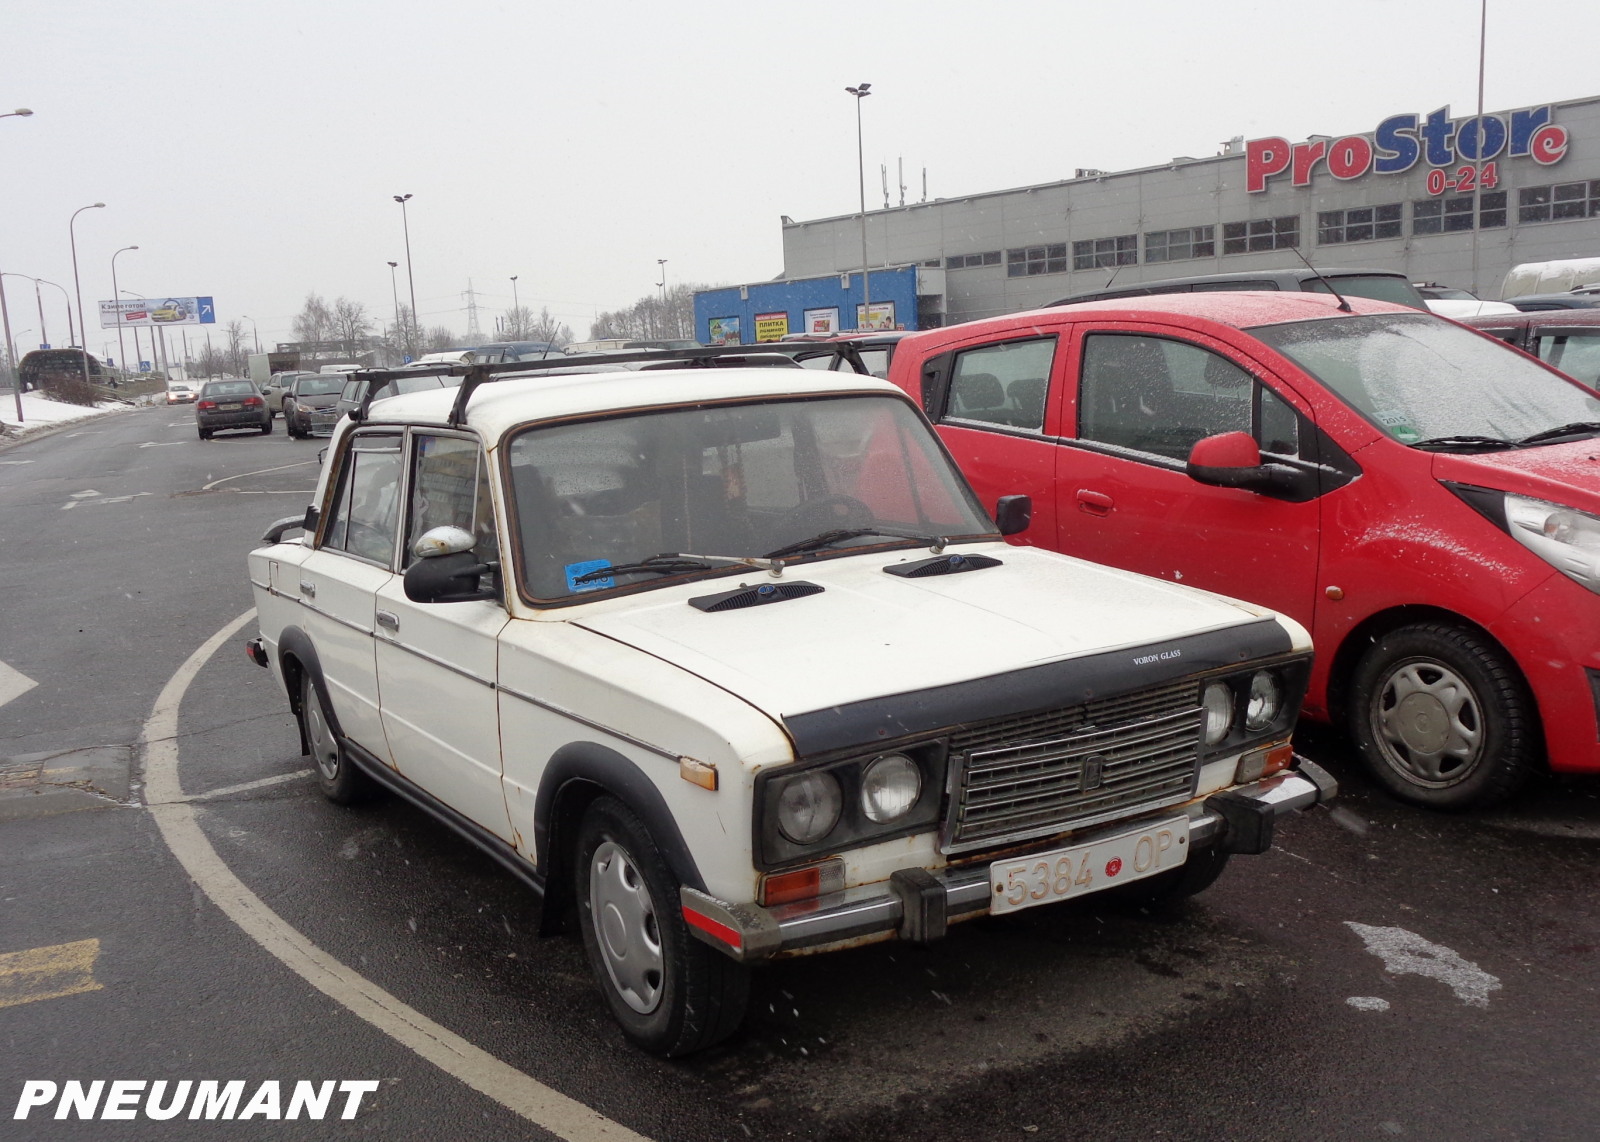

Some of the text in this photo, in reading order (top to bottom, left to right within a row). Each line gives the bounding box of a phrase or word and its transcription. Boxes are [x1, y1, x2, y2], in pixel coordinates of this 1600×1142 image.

[1246, 104, 1568, 194] ProStore
[1427, 162, 1498, 195] 0-24
[1133, 649, 1181, 665] VORON GLASS
[1006, 827, 1173, 906] 5384 OP
